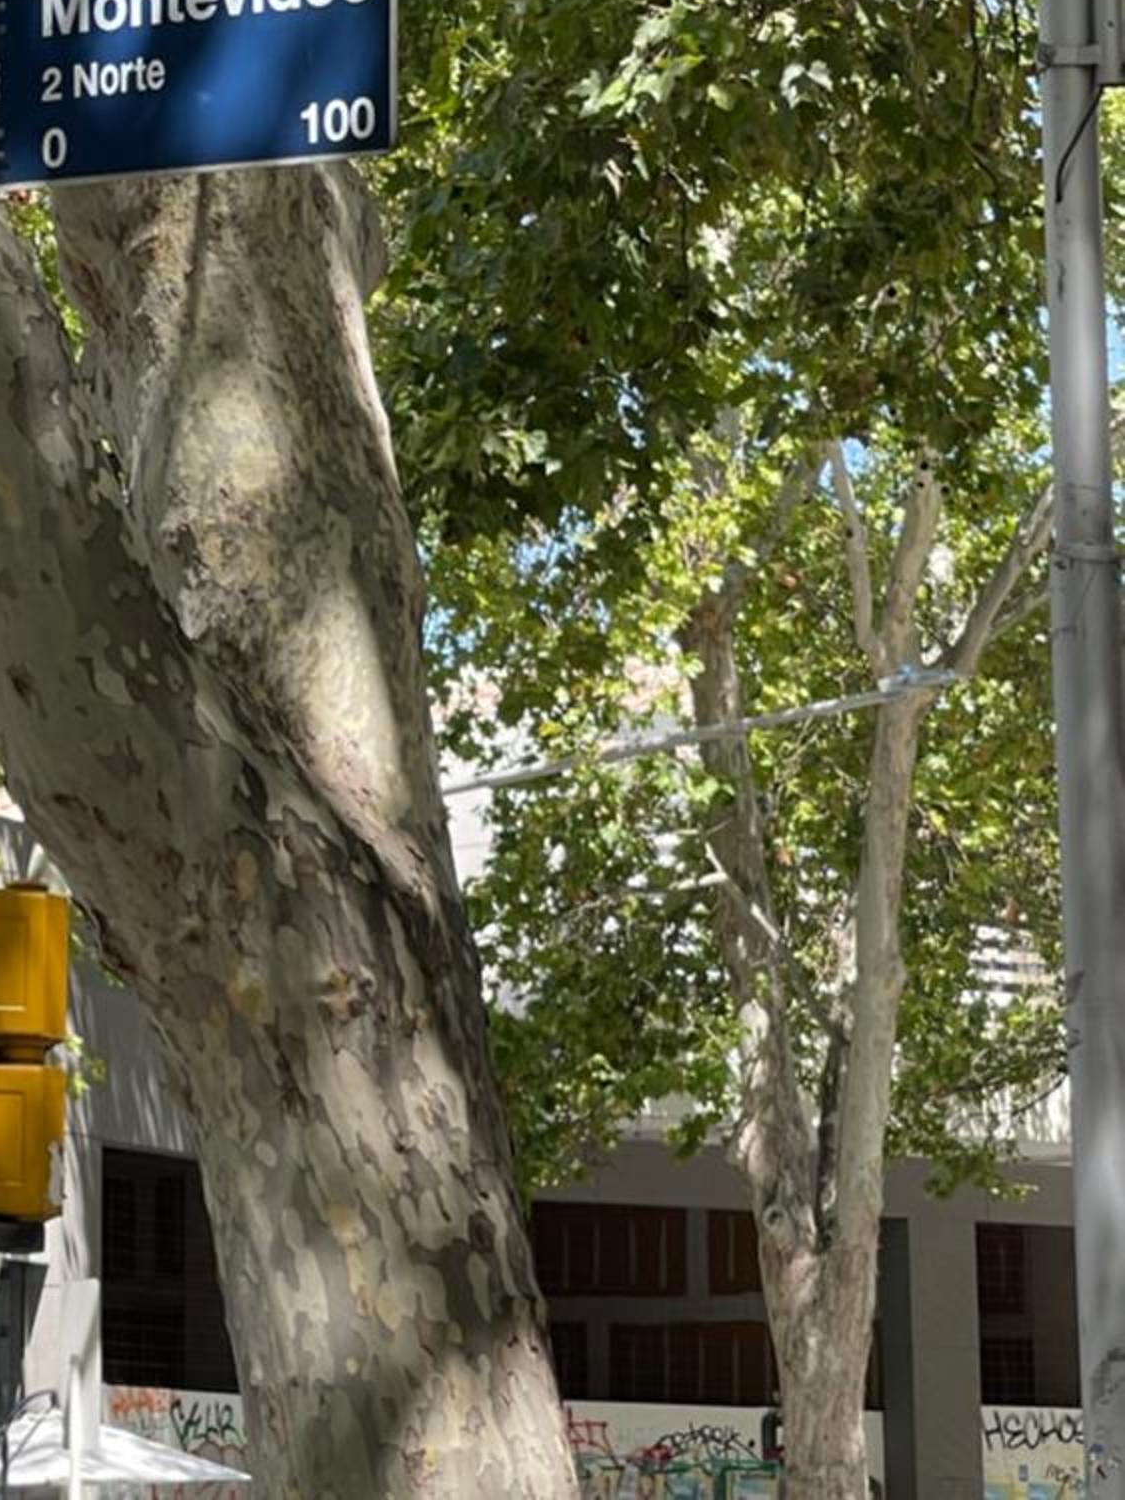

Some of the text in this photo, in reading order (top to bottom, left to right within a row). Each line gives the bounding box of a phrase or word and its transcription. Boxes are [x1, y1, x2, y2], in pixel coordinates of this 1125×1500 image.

[42, 56, 166, 102] 2 Norte
[300, 97, 375, 145] 100
[43, 128, 68, 169] 0
